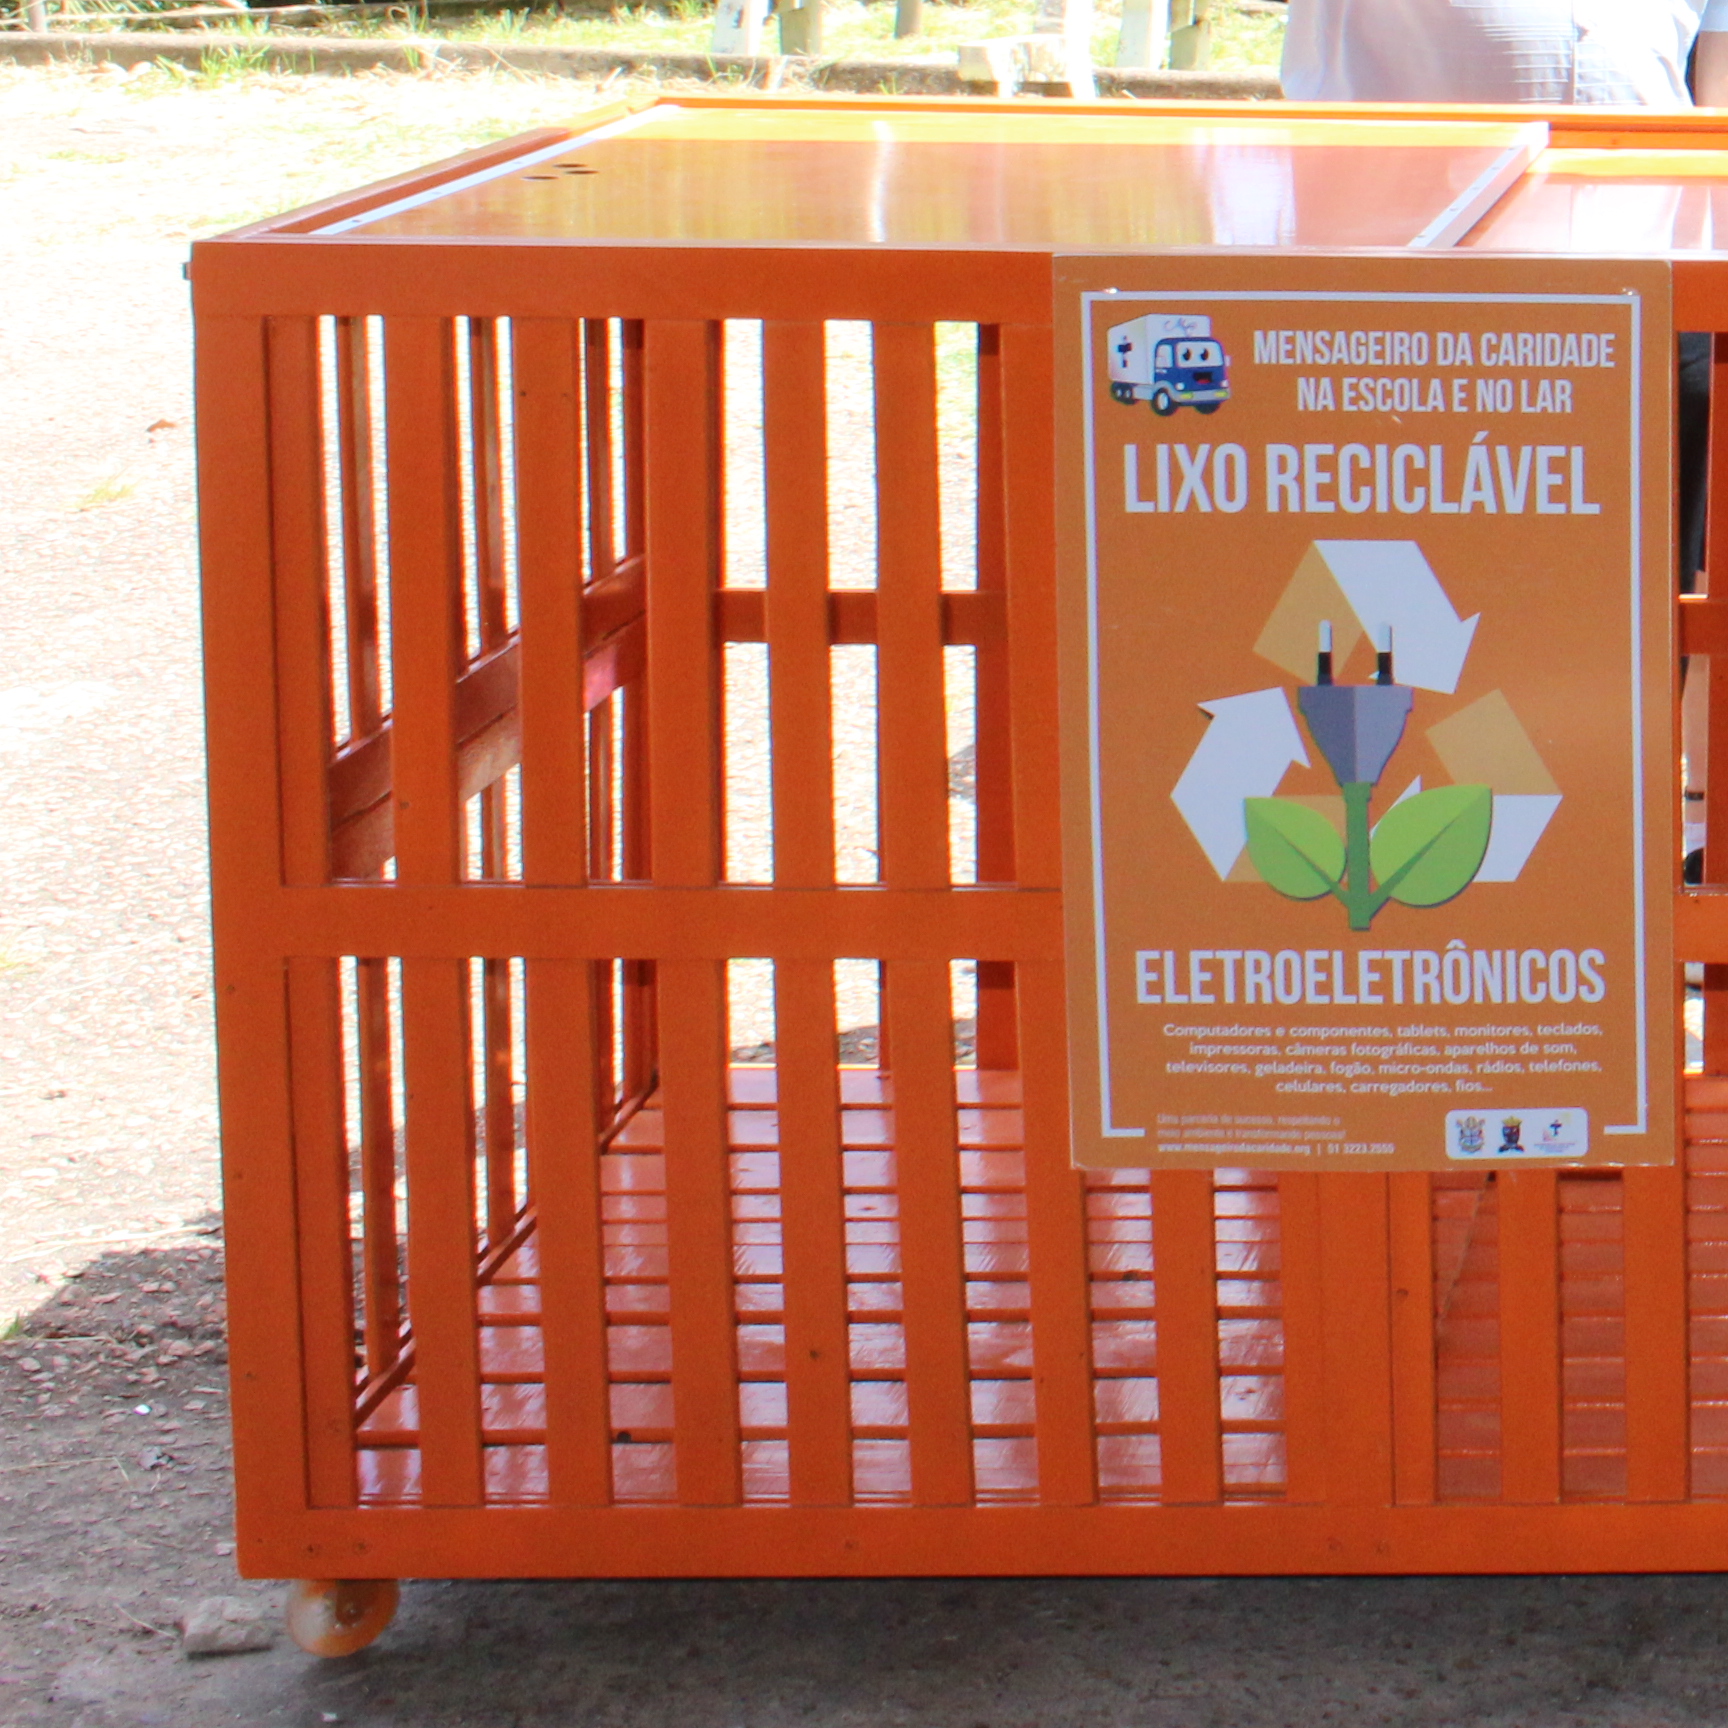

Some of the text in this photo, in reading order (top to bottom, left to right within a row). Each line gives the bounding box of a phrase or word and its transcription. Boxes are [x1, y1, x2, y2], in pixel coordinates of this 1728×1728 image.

[1253, 330, 1616, 368] MENSAGEIRO DA CARIDADE
[1296, 376, 1573, 414] NA ESCOLA E NO LAR
[1123, 430, 1601, 515] LIXO RECICLÁVEL
[1134, 938, 1606, 1006] ELETROELETRÔNICOS
[1163, 1023, 1603, 1040] Computadores e componentes, tablets, monitores, teclados,
[1189, 1041, 1282, 1057] impressoras,
[1285, 1042, 1347, 1056] câmeras
[1444, 1041, 1517, 1058] aparelhos
[1519, 1041, 1539, 1055] de
[1543, 1043, 1578, 1055] som,
[1166, 1060, 1251, 1074] televisores,
[1255, 1060, 1326, 1077] geladeira,
[1378, 1060, 1473, 1075] micro-ondas,
[1529, 1059, 1603, 1073] telefones,
[1275, 1078, 1347, 1093] celulares,
